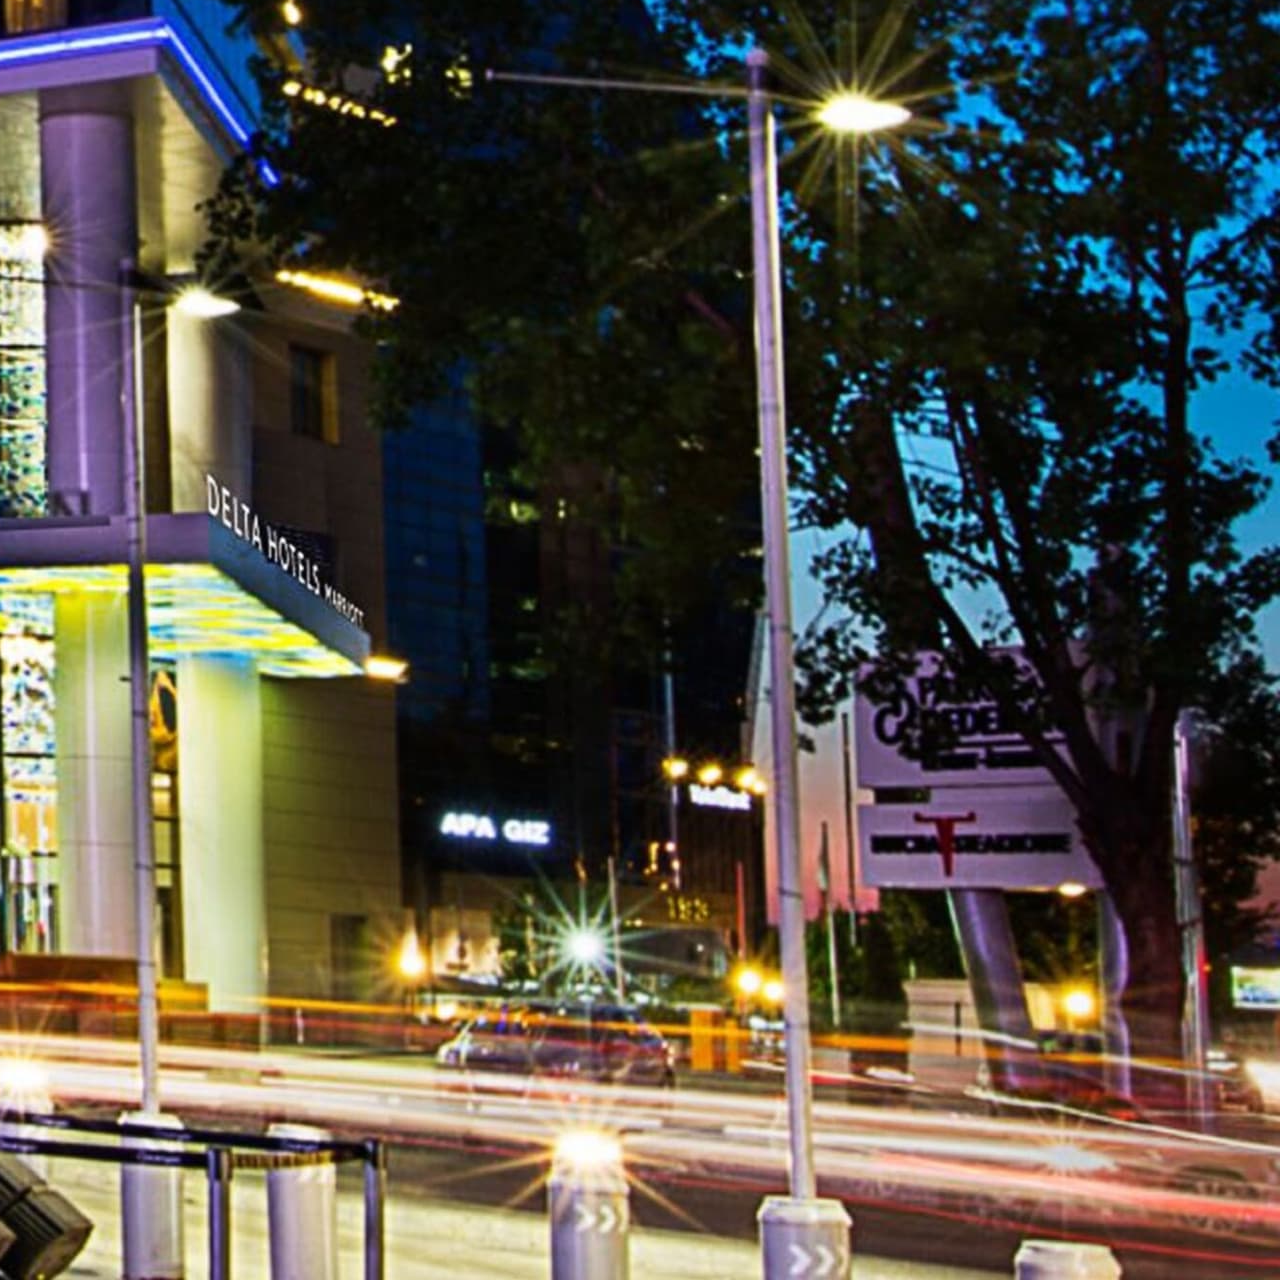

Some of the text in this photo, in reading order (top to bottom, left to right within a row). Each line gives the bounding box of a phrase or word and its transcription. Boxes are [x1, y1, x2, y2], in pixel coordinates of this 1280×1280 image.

[206, 473, 263, 553] DELTA
[265, 524, 321, 595] HOTELS
[440, 811, 497, 839] APA
